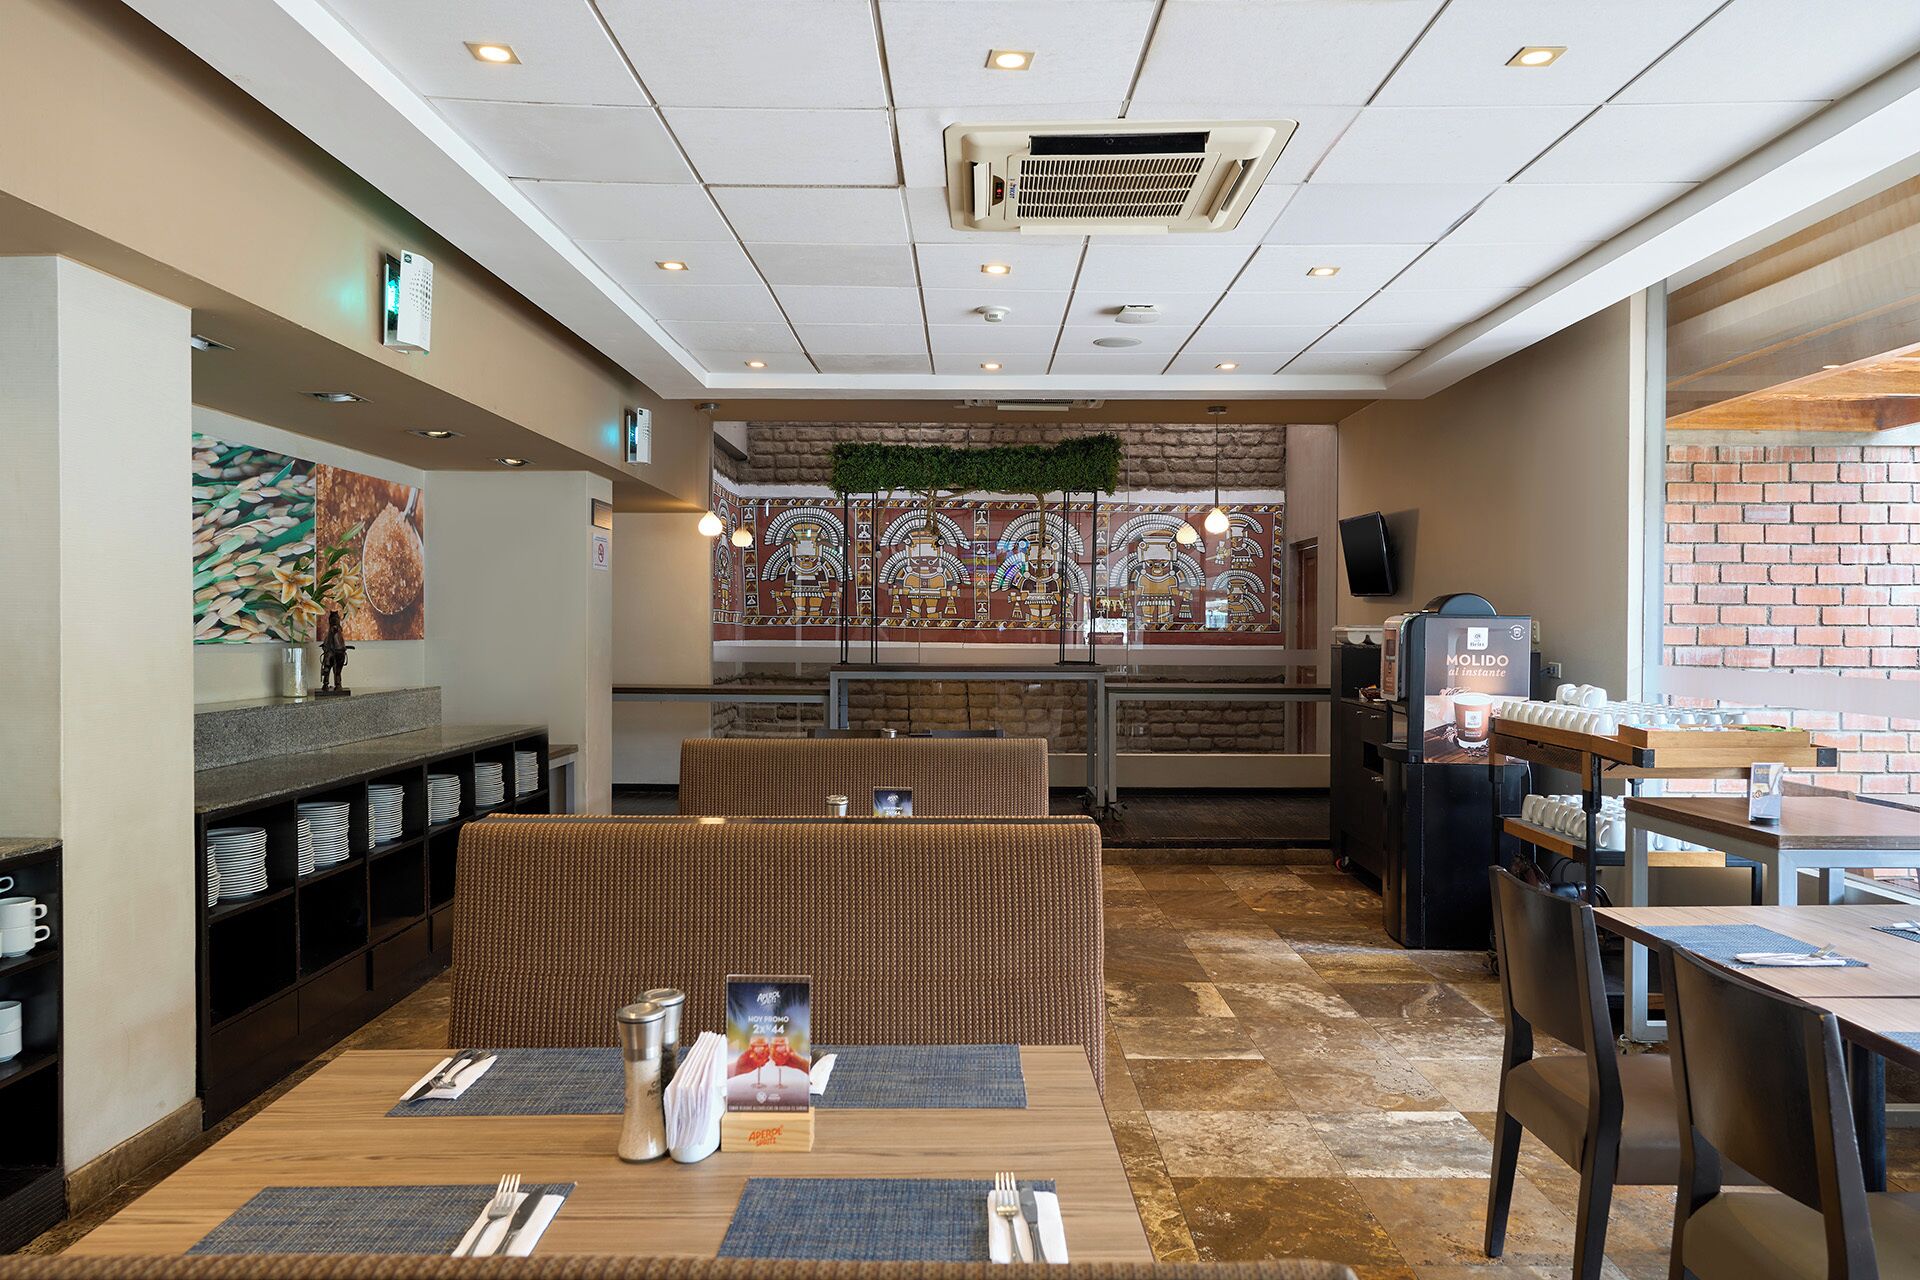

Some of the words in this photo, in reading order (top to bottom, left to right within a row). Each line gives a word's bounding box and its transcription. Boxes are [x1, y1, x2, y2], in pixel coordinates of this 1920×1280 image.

[1446, 654, 1509, 667] MOLIDO
[1448, 667, 1460, 676] al
[1462, 667, 1507, 677] instante
[748, 1015, 763, 1023] HOY
[764, 1015, 790, 1023] PROMO
[748, 1127, 783, 1142] APEROL
